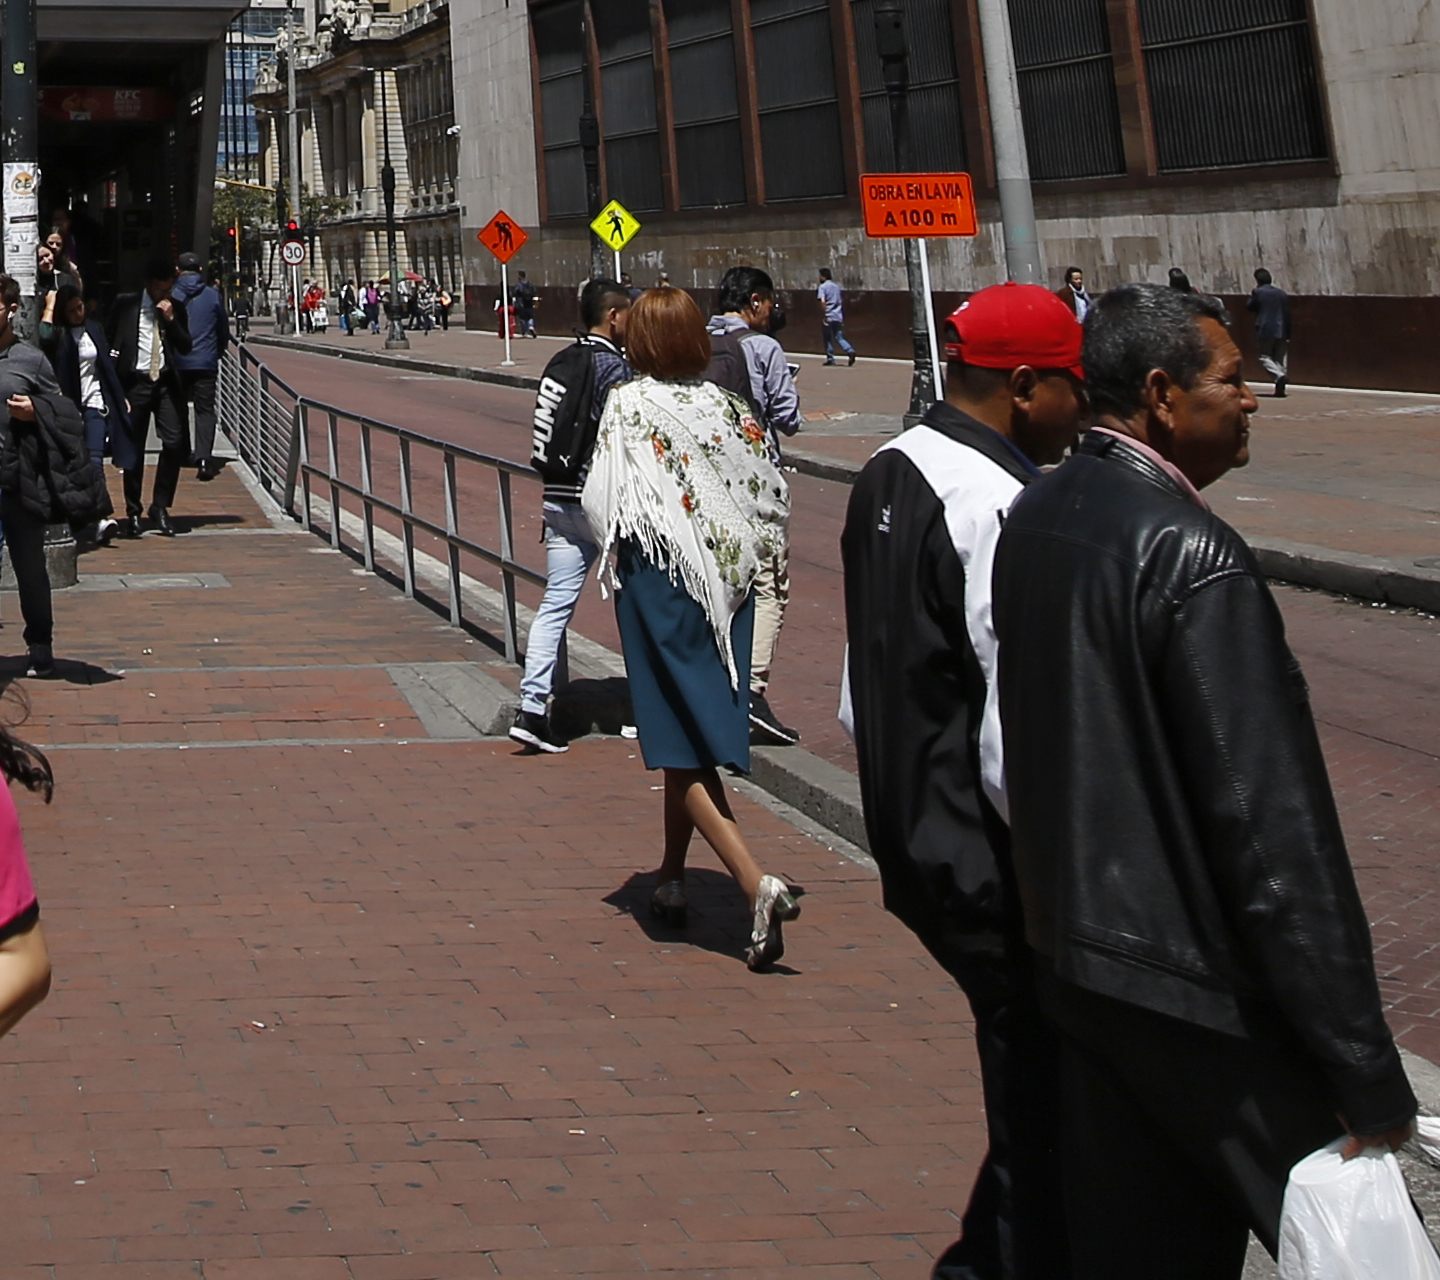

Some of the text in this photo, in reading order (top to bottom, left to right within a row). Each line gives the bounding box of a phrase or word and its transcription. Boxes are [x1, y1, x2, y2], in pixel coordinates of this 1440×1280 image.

[114, 91, 140, 100] KFC
[869, 184, 905, 201] OBRA
[906, 183, 924, 200] EN
[884, 209, 958, 227] A 100 m
[285, 245, 303, 260] 30
[532, 376, 568, 464] PUMA
